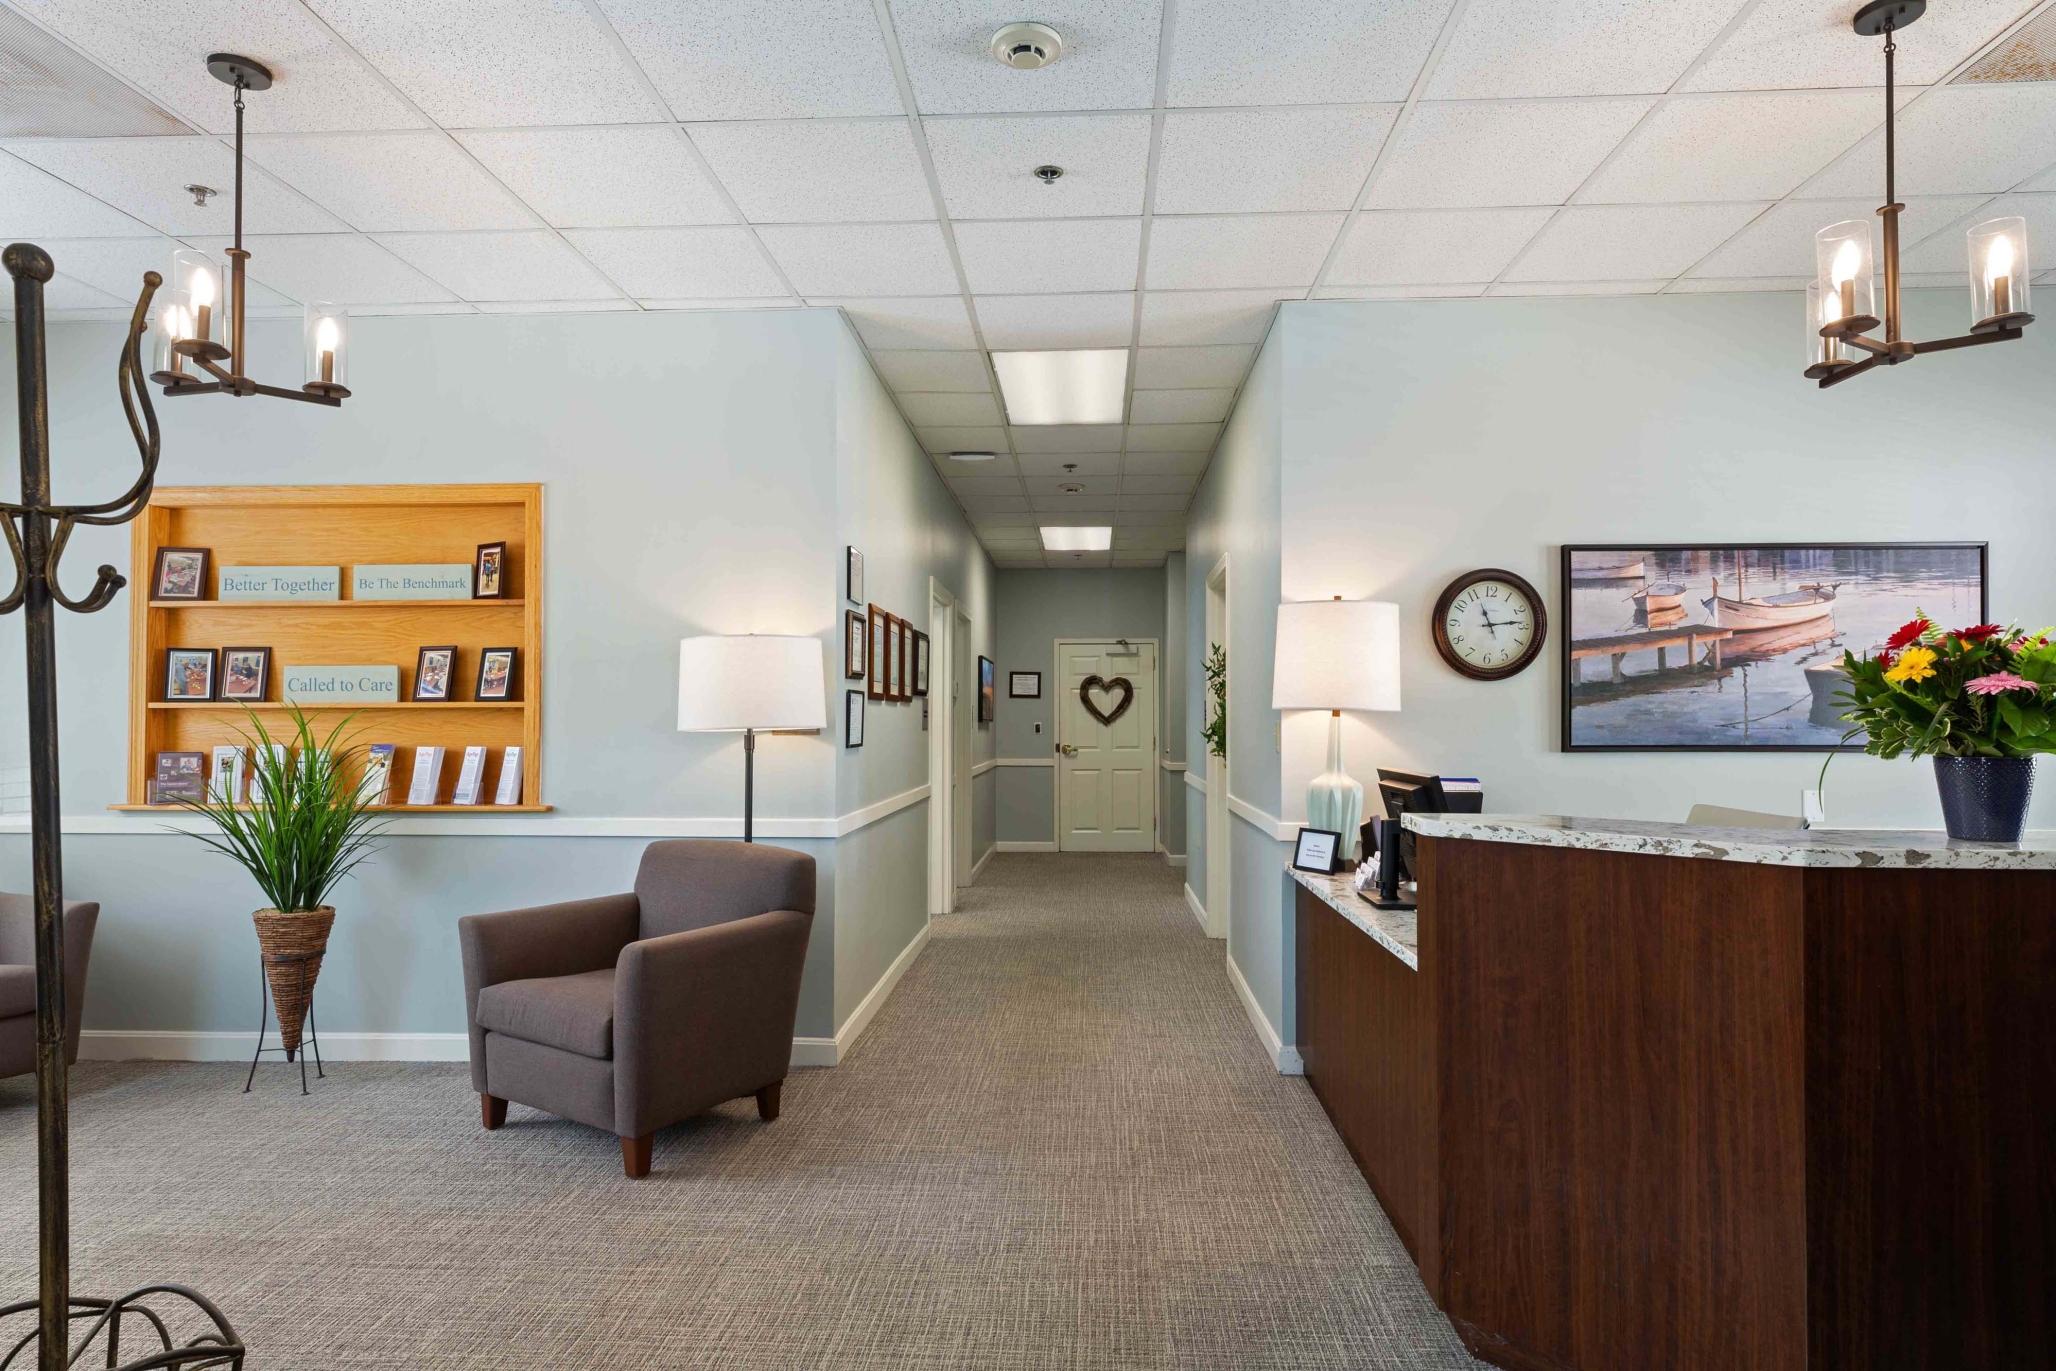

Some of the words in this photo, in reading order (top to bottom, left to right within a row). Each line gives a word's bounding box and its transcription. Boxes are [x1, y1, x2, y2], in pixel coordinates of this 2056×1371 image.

[223, 578, 267, 592] Better
[271, 578, 335, 595] Together
[359, 578, 374, 589] Be
[377, 578, 399, 589] The
[402, 577, 466, 589] Benchmark
[1468, 589, 1480, 602] 11
[1485, 586, 1497, 597] 12
[1504, 593, 1512, 602] 1
[1455, 600, 1467, 613] 10
[1514, 605, 1526, 615] 2
[1518, 621, 1530, 630] 3
[1453, 635, 1464, 644] 8
[1513, 638, 1523, 647] 4
[1465, 647, 1475, 657] 7
[1500, 649, 1508, 661] 5
[1483, 653, 1491, 664] 6
[287, 677, 335, 692] Called
[340, 679, 354, 692] to
[358, 677, 393, 692] Care
